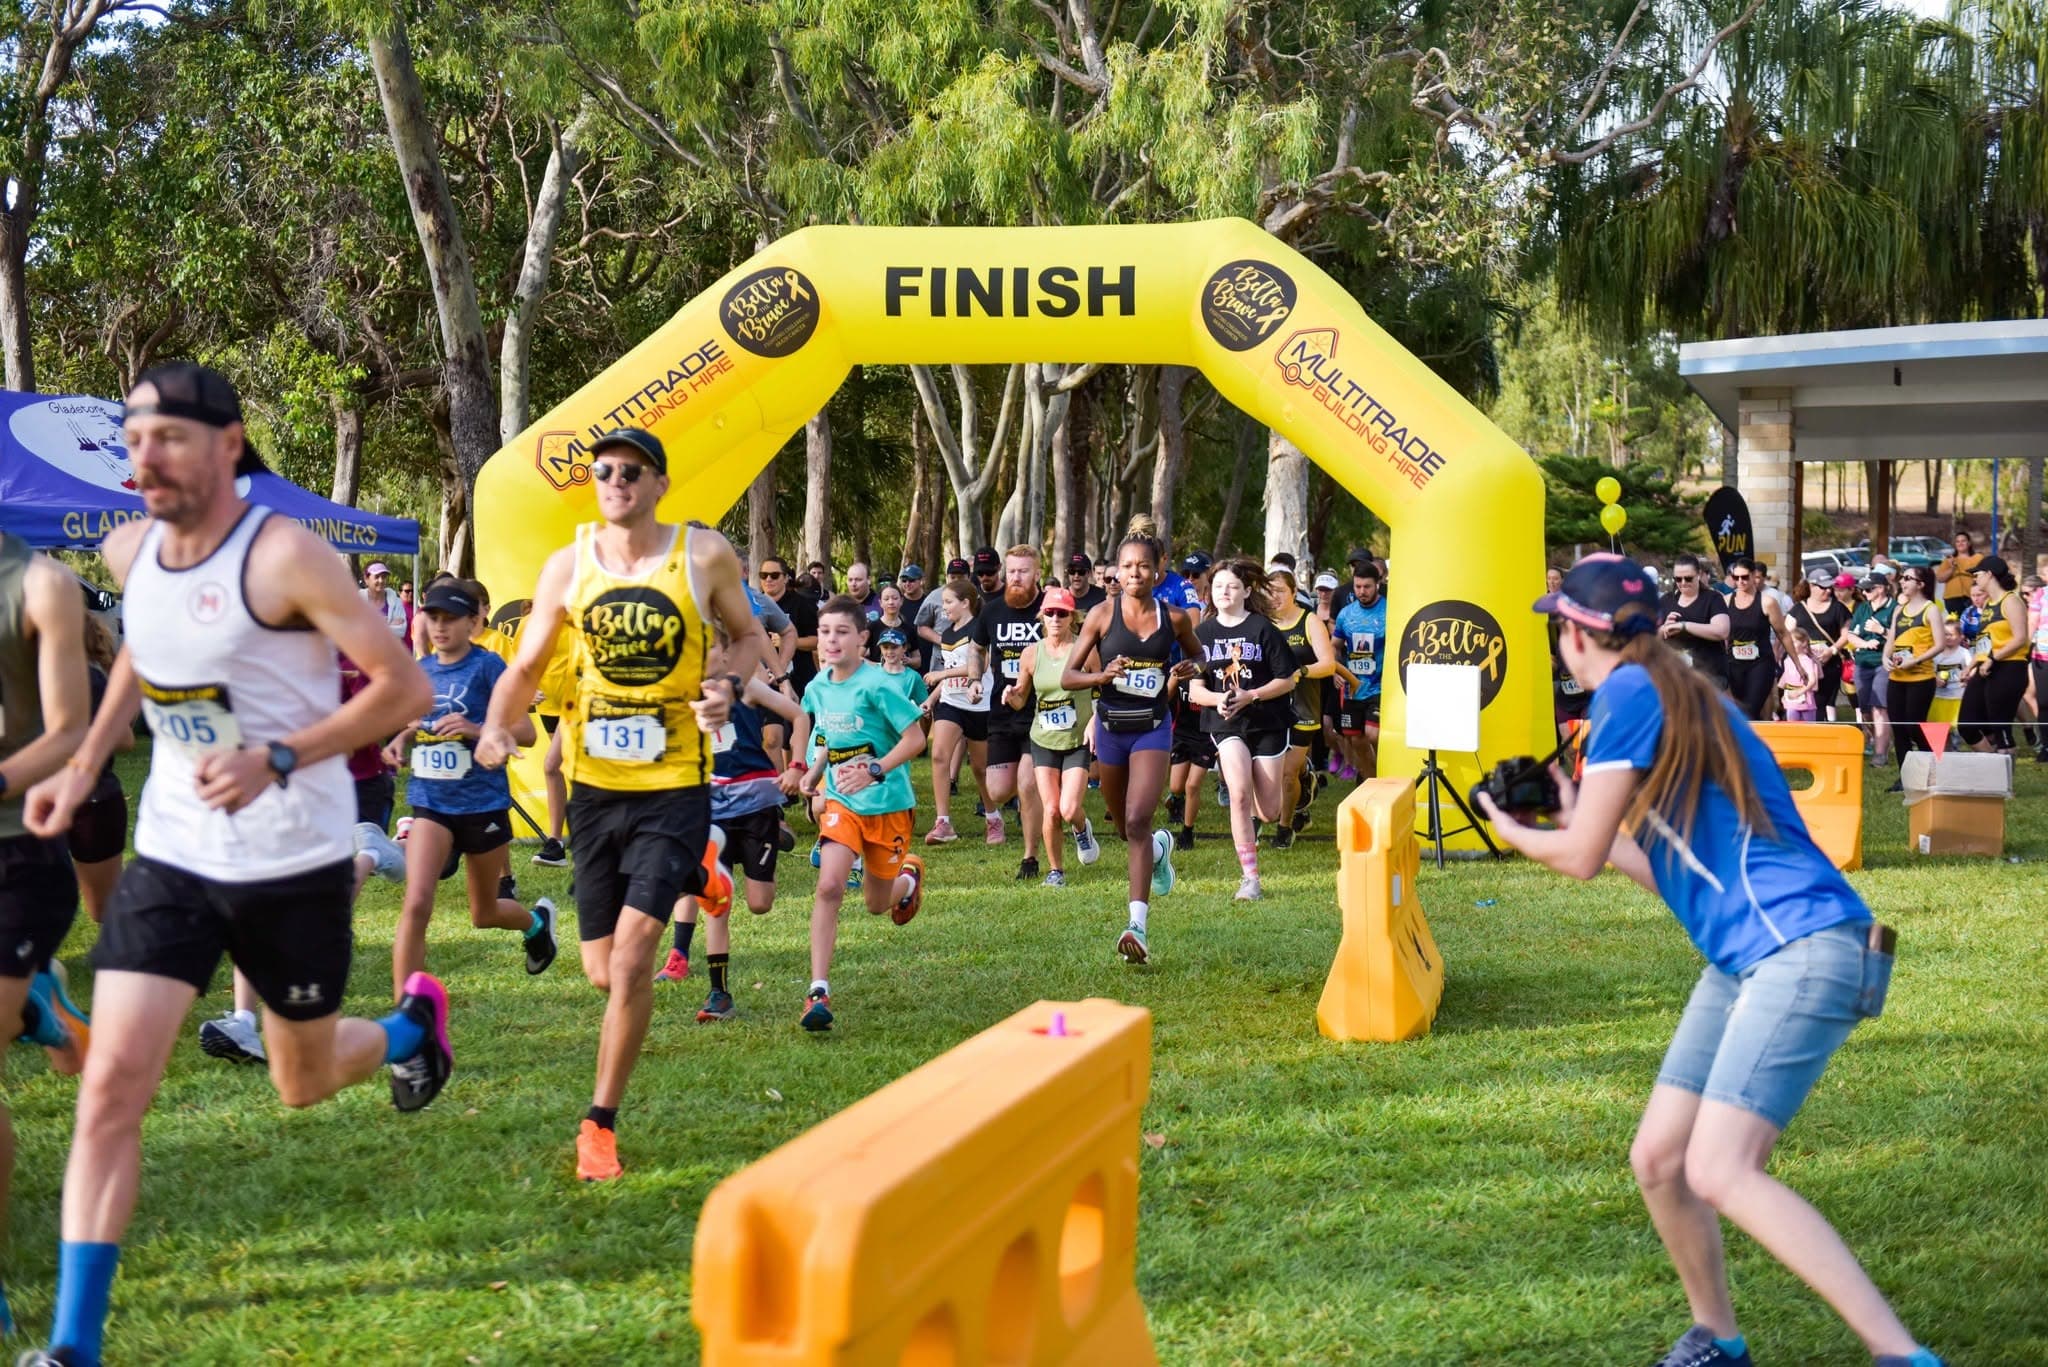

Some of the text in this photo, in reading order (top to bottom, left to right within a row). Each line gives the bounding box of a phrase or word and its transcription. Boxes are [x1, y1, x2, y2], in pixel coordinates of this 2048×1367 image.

[727, 275, 784, 319] Bella
[885, 265, 1136, 318] FINISH
[1210, 278, 1257, 319] Brave
[1233, 266, 1285, 308] Bella
[737, 298, 790, 342] Brave
[689, 355, 735, 393] HIRE
[1290, 340, 1447, 477] MULTITRADE
[1311, 384, 1430, 491] BUILDING HIRE
[997, 623, 1041, 641] UBX
[1410, 618, 1489, 656] Bella
[1126, 672, 1157, 690] 156
[1353, 661, 1370, 670] 139
[153, 705, 217, 745] 205
[599, 723, 646, 750] 131
[1044, 711, 1068, 724] 181
[420, 751, 458, 770] 190
